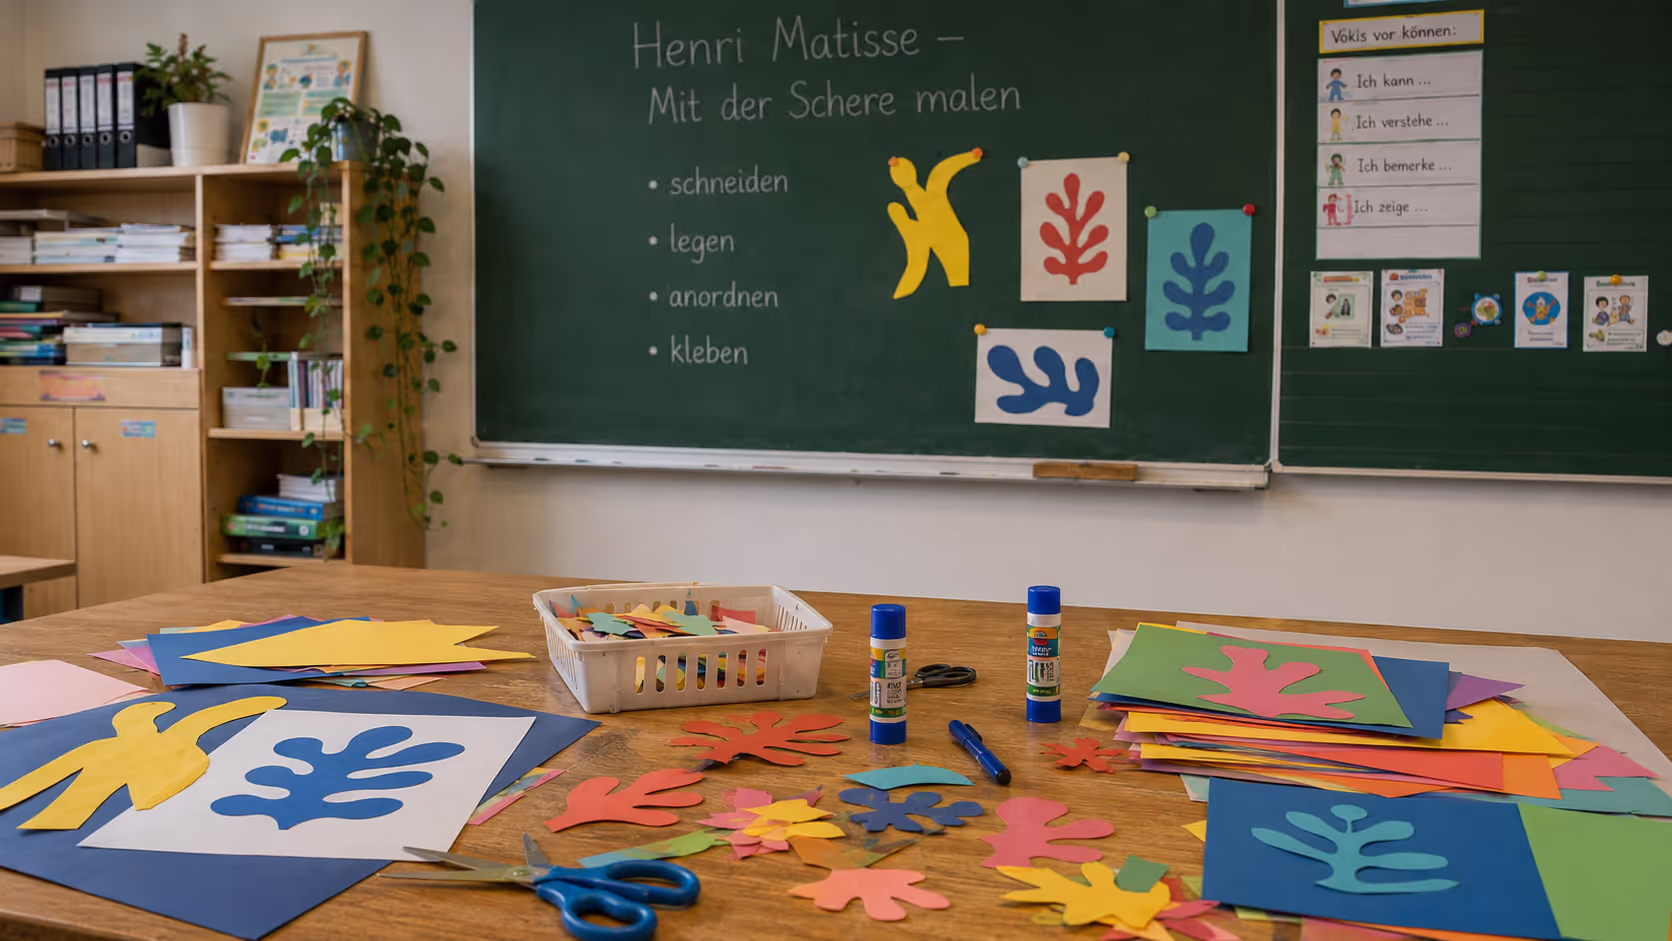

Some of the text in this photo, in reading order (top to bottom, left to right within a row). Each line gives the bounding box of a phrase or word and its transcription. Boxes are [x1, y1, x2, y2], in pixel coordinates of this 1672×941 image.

[633, 20, 744, 69] Henri
[772, 15, 920, 62] Matisse
[1373, 31, 1397, 42] vor
[1402, 25, 1457, 40] können:
[1356, 74, 1377, 89] Ich
[1383, 74, 1415, 87] kann
[648, 73, 1021, 125] Mit der Schere malen
[1356, 115, 1376, 130] Ich
[1381, 113, 1433, 129] verstehe
[1358, 158, 1379, 173] Ich
[1384, 158, 1436, 173] bemerke
[669, 165, 789, 195] schneiden
[1354, 200, 1374, 215] Ich
[1378, 201, 1410, 216] zeige
[669, 223, 735, 264] legen
[669, 281, 779, 308] anordnen
[670, 335, 749, 365] kleben
